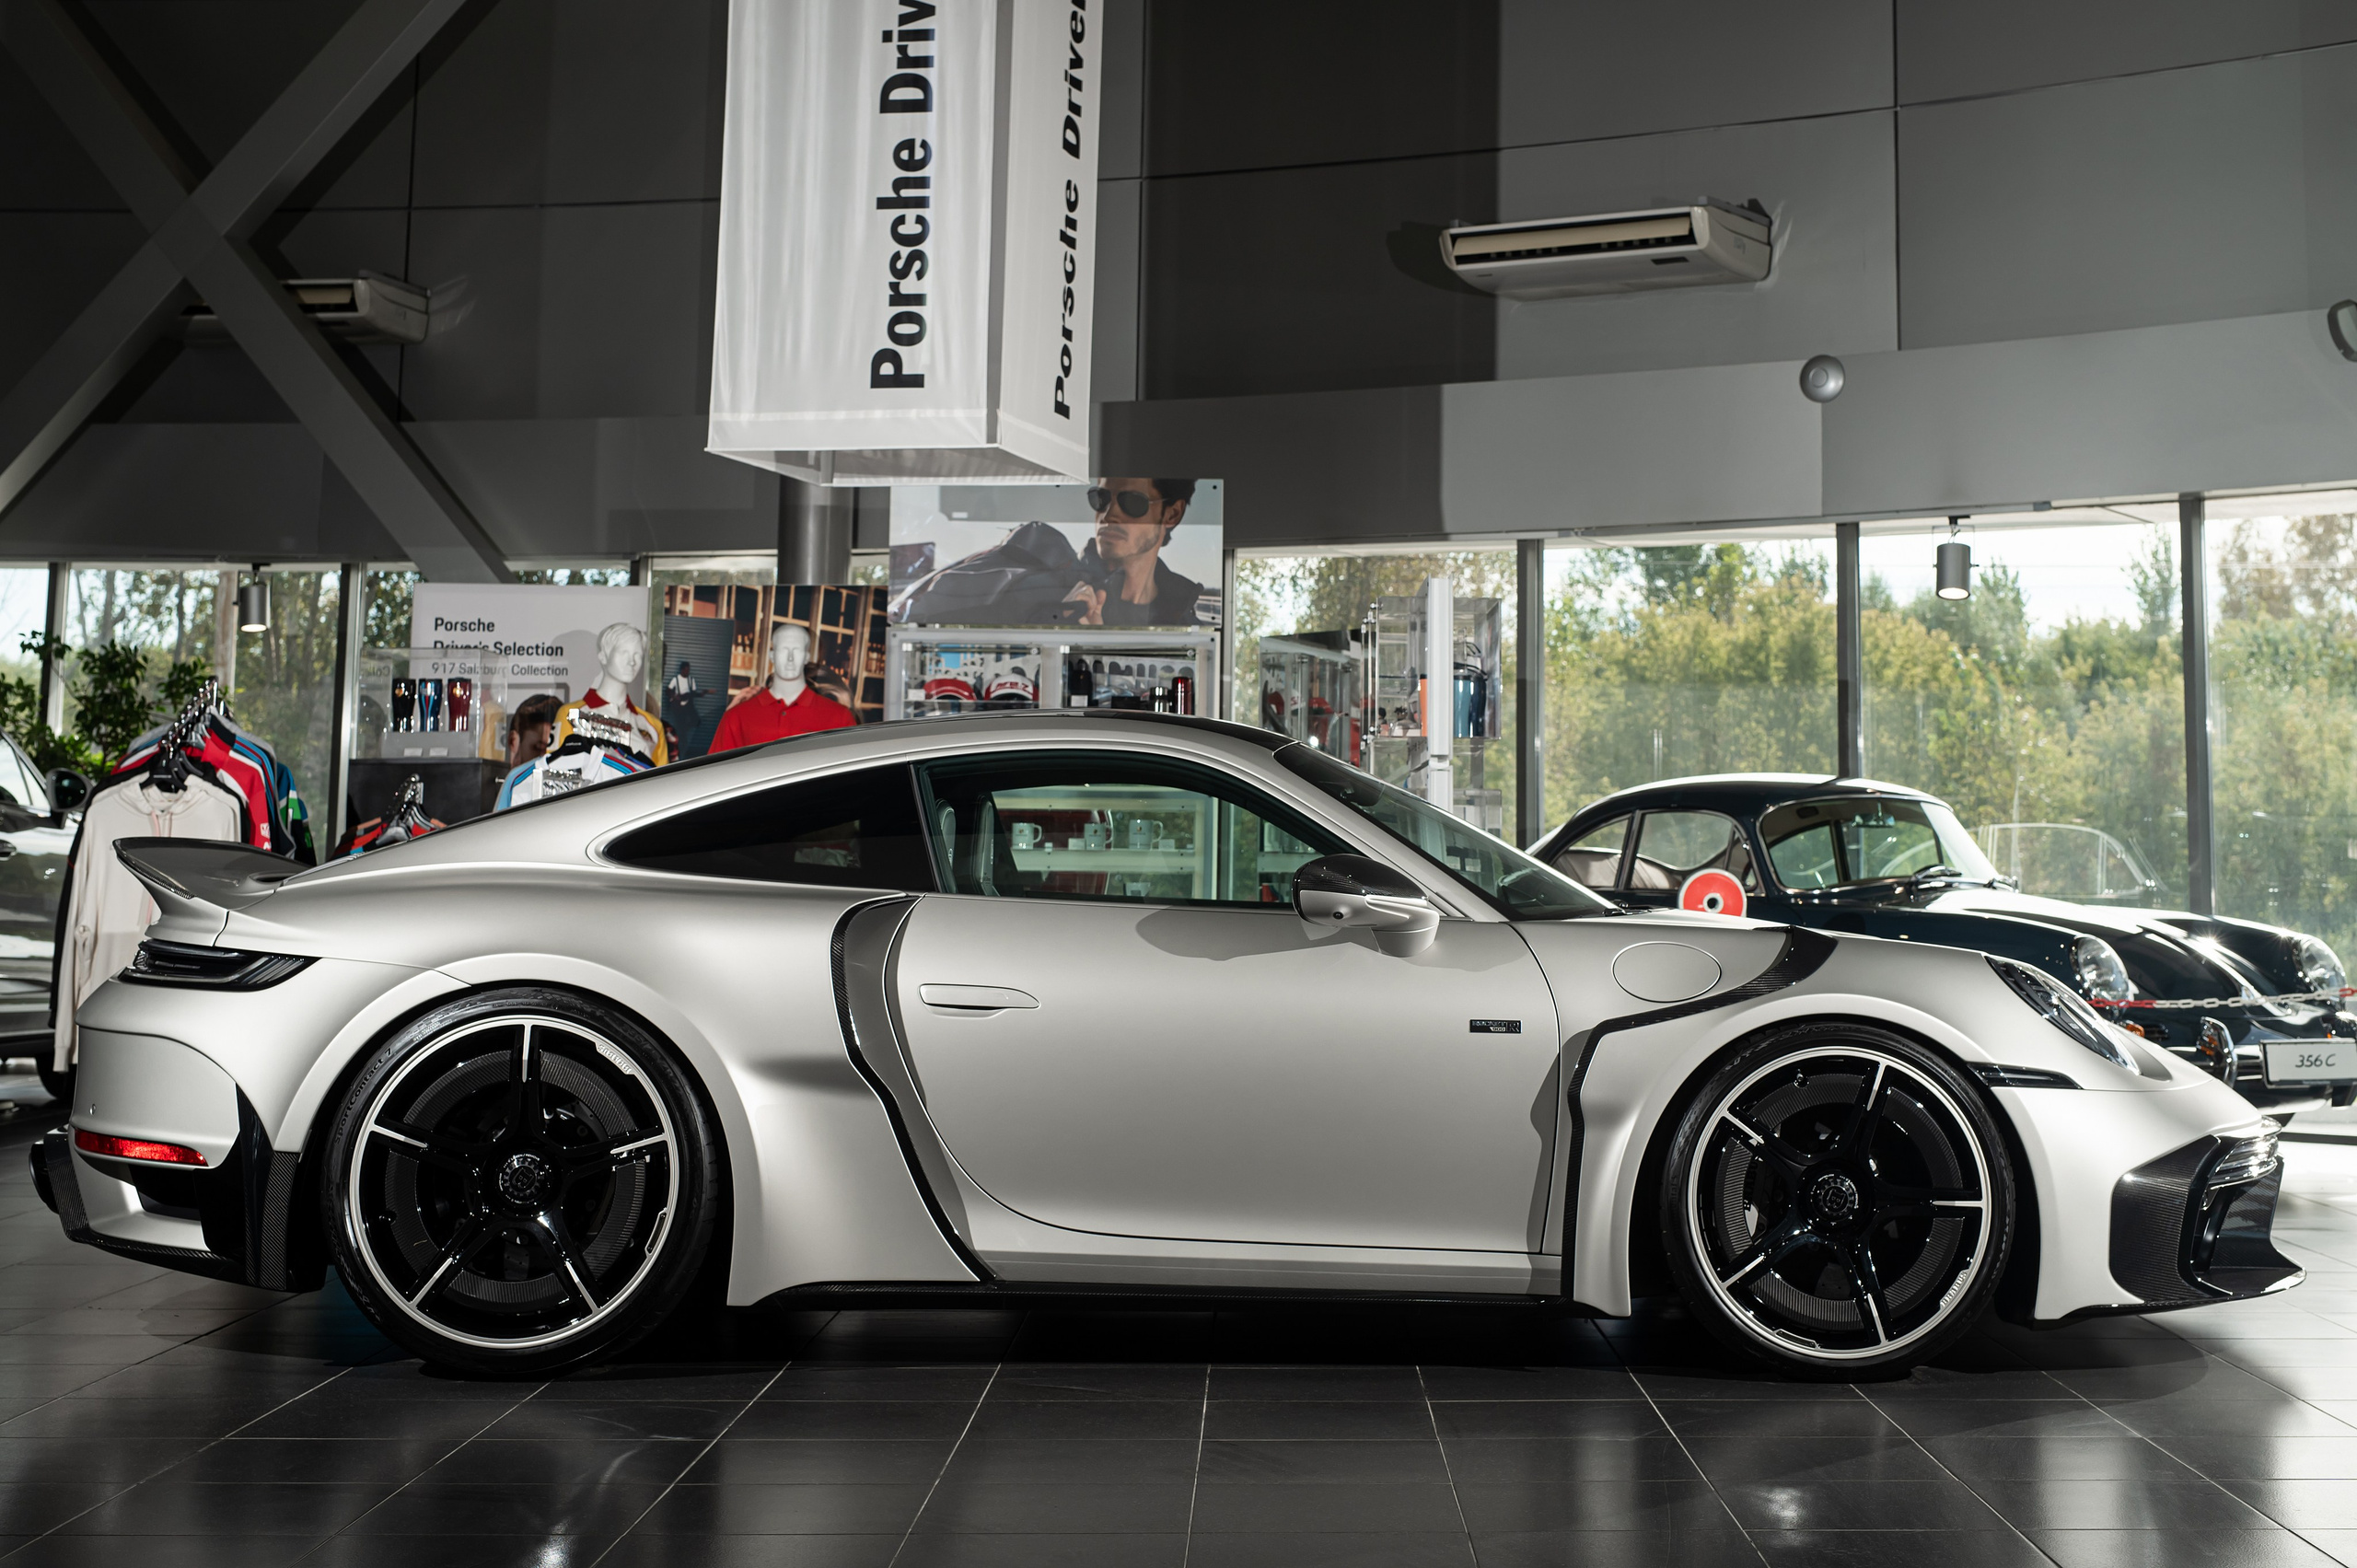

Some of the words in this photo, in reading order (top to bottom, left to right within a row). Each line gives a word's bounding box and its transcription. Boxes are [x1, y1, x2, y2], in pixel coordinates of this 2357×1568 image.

[879, 0, 936, 114] Driv
[870, 137, 932, 389] Porsche
[1054, 179, 1080, 420] Porsche
[434, 617, 495, 633] Porsche
[493, 641, 564, 656] Selection
[432, 662, 456, 675] 917
[511, 664, 568, 677] Collection
[2294, 1054, 2323, 1068] 356
[2325, 1053, 2336, 1067] C
[334, 1057, 384, 1144] SportContact
[1939, 1271, 1968, 1307] BRABUS
